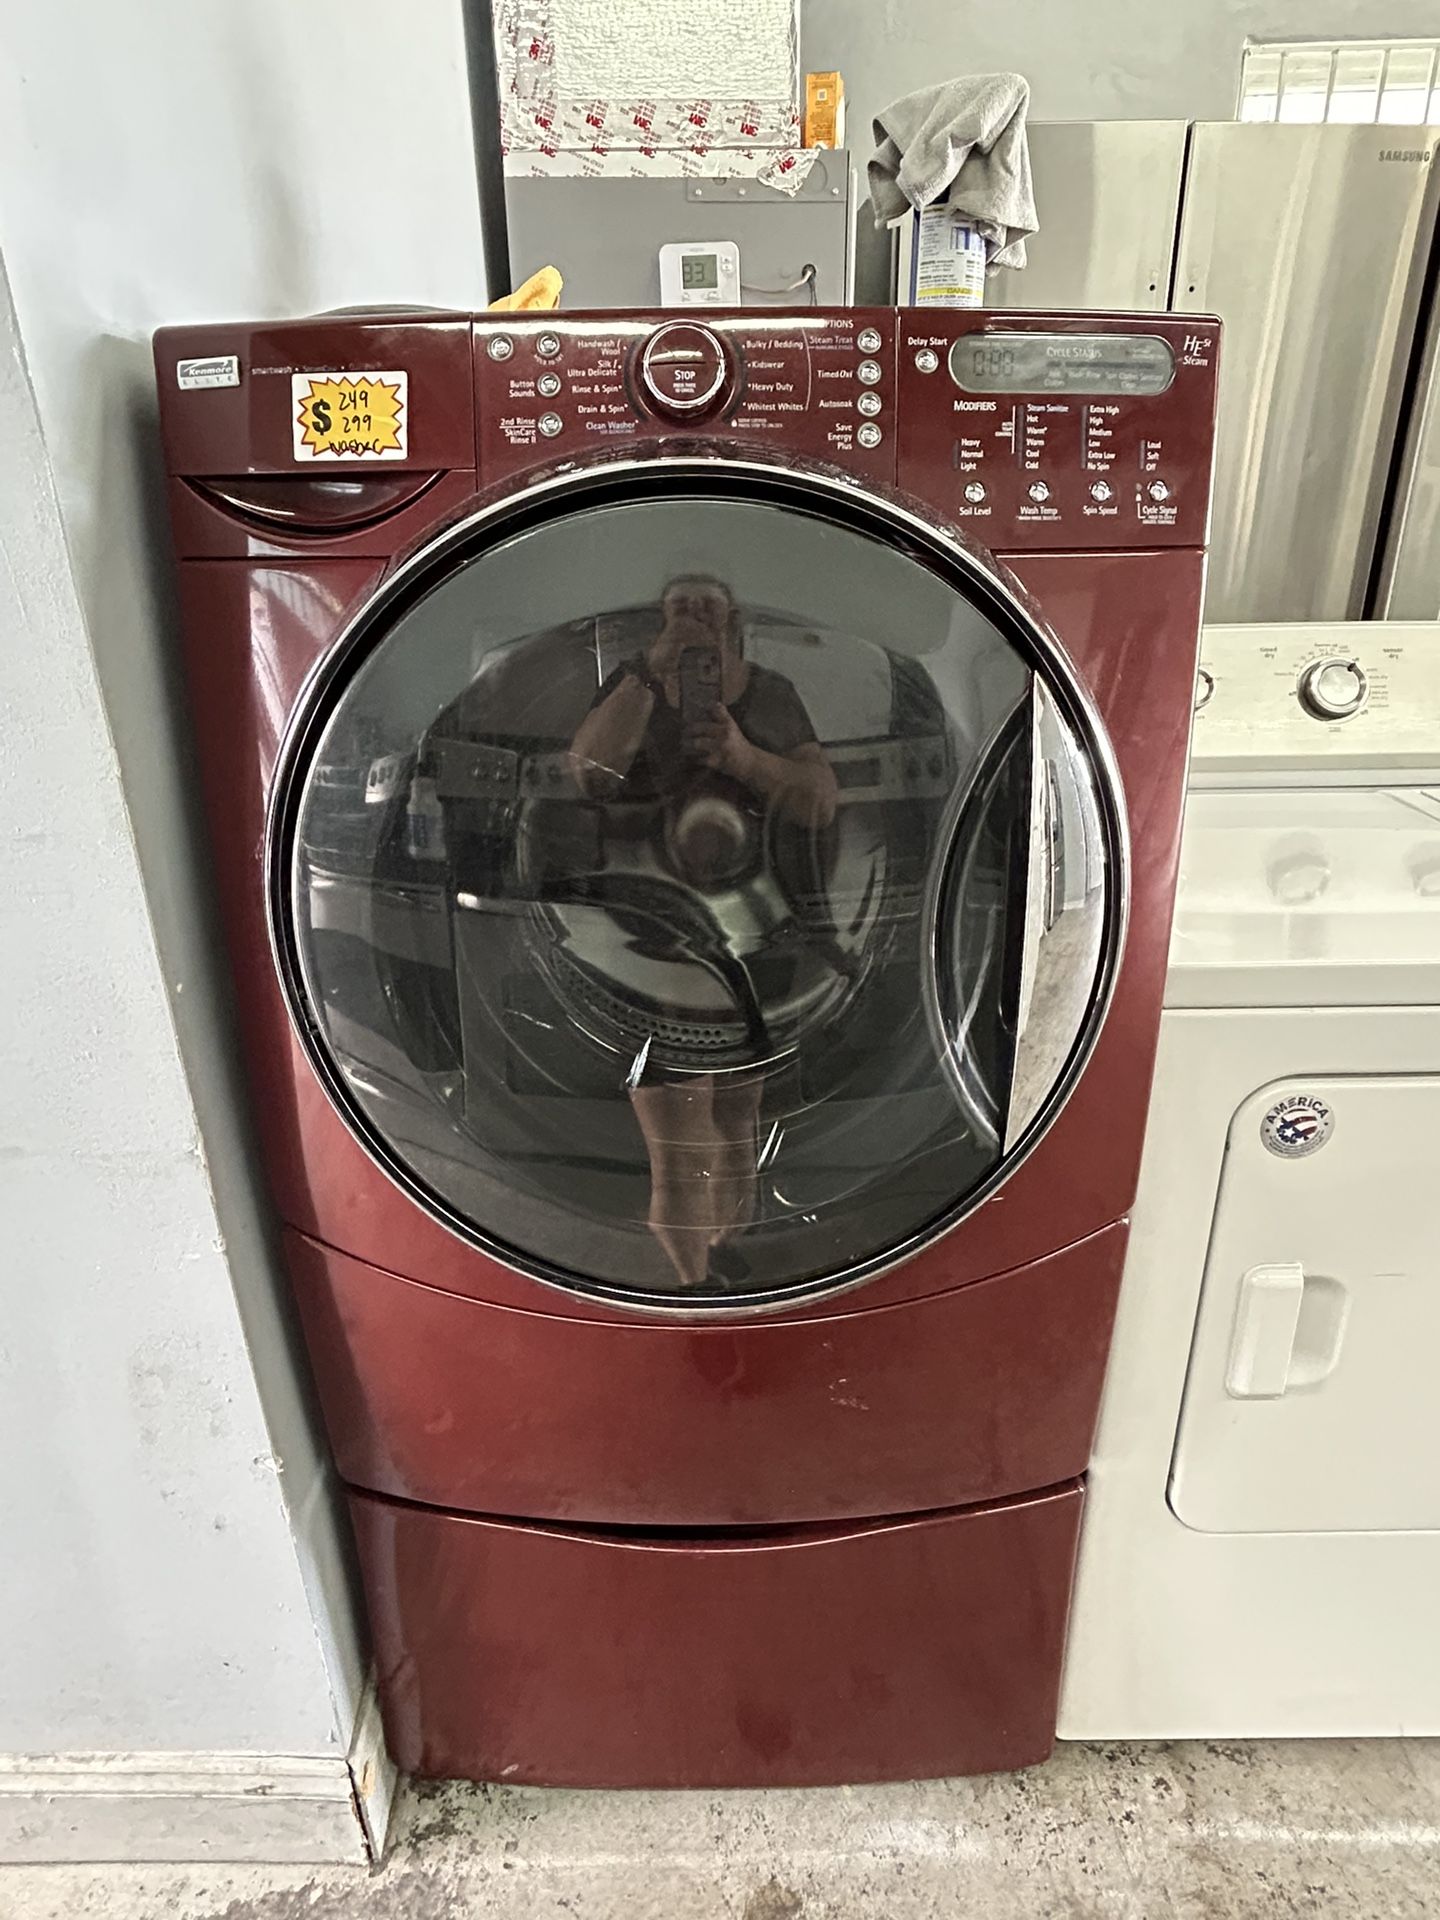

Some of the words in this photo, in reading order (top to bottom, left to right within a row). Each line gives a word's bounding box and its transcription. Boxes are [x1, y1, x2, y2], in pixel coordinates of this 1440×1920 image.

[535, 115, 552, 130] 3M
[586, 114, 604, 128] 3M
[634, 115, 652, 130] 3M
[689, 113, 707, 128] 3M
[740, 123, 758, 136] 3M
[1378, 150, 1430, 162] SAMSUNG
[779, 156, 797, 174] 3M
[824, 319, 854, 328] PTIONS
[578, 340, 615, 348] Handwash
[810, 336, 833, 344] Steam
[836, 336, 854, 344] Treat
[908, 336, 928, 346] Delay
[930, 336, 948, 346] Start
[746, 340, 766, 350] Bulky
[774, 340, 803, 350] Bedding
[598, 360, 612, 368] Silk
[1183, 355, 1208, 366] Steam
[188, 366, 232, 376] Kenmore
[567, 369, 586, 377] Ultra
[588, 368, 617, 376] Delicate
[674, 370, 696, 380] STOP
[572, 385, 592, 393] Rinse
[602, 385, 619, 394] Spin
[751, 383, 774, 392] Heavy
[776, 382, 794, 392] Duty
[509, 390, 535, 398] Sounds
[747, 402, 776, 411] Whitest
[778, 402, 804, 411] Whites
[819, 400, 853, 408] Autosoak
[954, 400, 997, 411] MODIFIERS
[1027, 404, 1046, 412] Steam
[312, 398, 332, 436] $
[338, 390, 368, 410] 249
[578, 405, 598, 413] Drain
[608, 405, 625, 414] Spin
[1090, 405, 1104, 413] Extra
[1106, 406, 1120, 416] High
[342, 414, 371, 434] 299
[586, 422, 606, 430] Clean
[608, 421, 635, 429] Washer
[1089, 416, 1103, 426] High
[836, 423, 852, 431] Save
[505, 429, 536, 437] SkinCare
[1089, 428, 1112, 436] Medium
[828, 433, 852, 443] Energy
[837, 442, 852, 450] Plus
[961, 439, 981, 448] Heavy
[1088, 439, 1100, 447] Low
[1147, 441, 1162, 449] Loud
[961, 450, 984, 458] Normal
[1088, 451, 1103, 459] Extra
[1146, 451, 1160, 460] Soft
[960, 462, 977, 472] Light
[1025, 461, 1039, 469] Cold
[1097, 462, 1110, 471] Spin
[1146, 463, 1157, 471] Off
[959, 506, 973, 515] Soil
[974, 506, 992, 515] Level
[1020, 506, 1039, 514] Wash
[1040, 506, 1058, 515] Temp
[1083, 505, 1098, 516] Spin
[1099, 505, 1118, 516] Speed
[1142, 505, 1158, 515] Cycle
[1159, 506, 1177, 516] Signal
[1266, 1096, 1329, 1124] AMERICA
